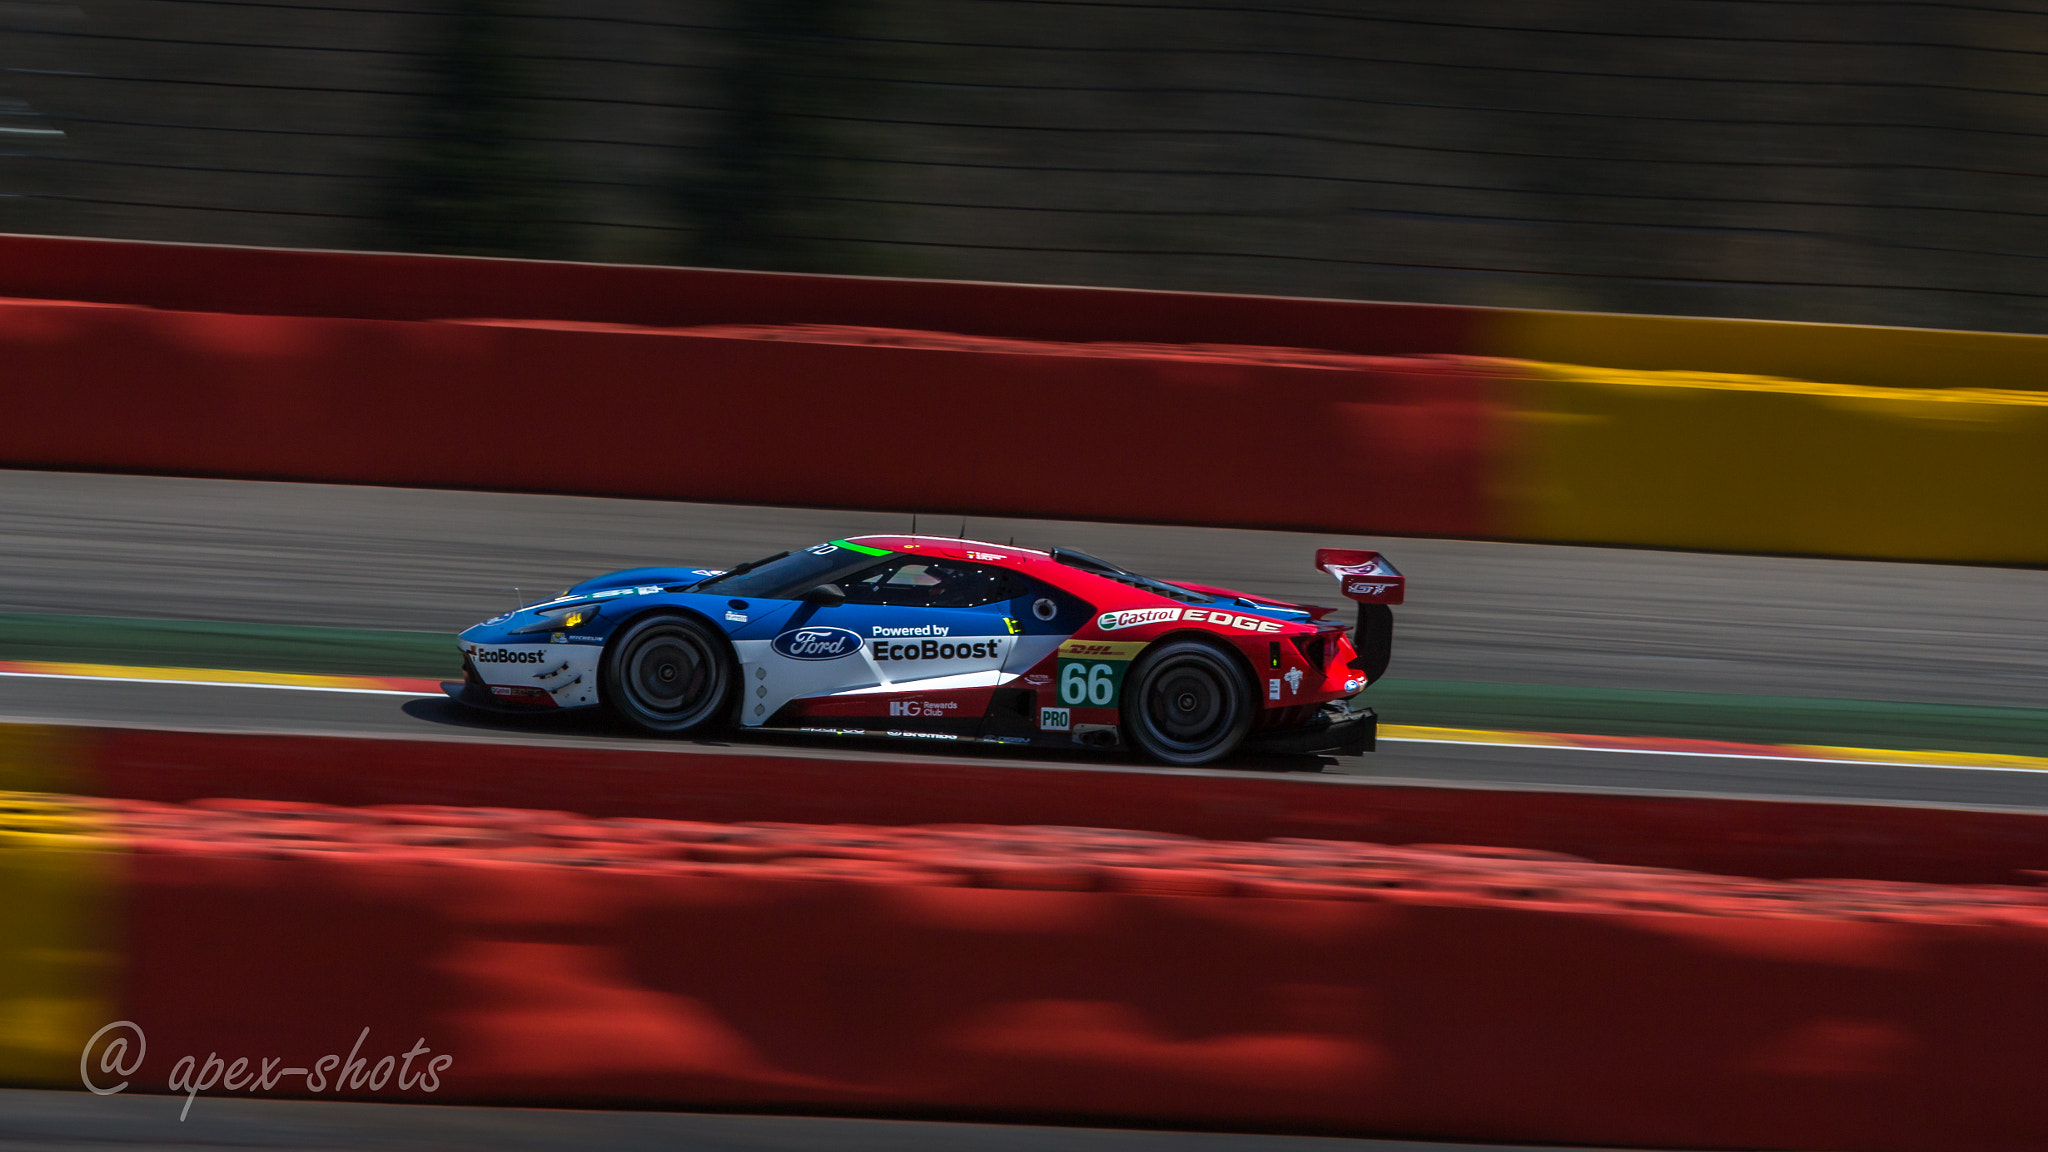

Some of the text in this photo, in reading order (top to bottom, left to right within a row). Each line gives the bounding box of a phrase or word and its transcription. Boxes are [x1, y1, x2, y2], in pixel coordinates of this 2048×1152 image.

[1117, 609, 1285, 633] Castrol EDGE
[872, 625, 949, 637] Powered by
[790, 630, 845, 654] Ford
[872, 638, 1001, 661] EcoBoost
[1069, 643, 1114, 656] DHL
[478, 648, 546, 664] EcoBoost
[1060, 662, 1114, 706] 66
[889, 701, 921, 717] IHG
[923, 701, 958, 710] Rewards
[923, 708, 943, 717] Club
[1042, 711, 1068, 728] PRO
